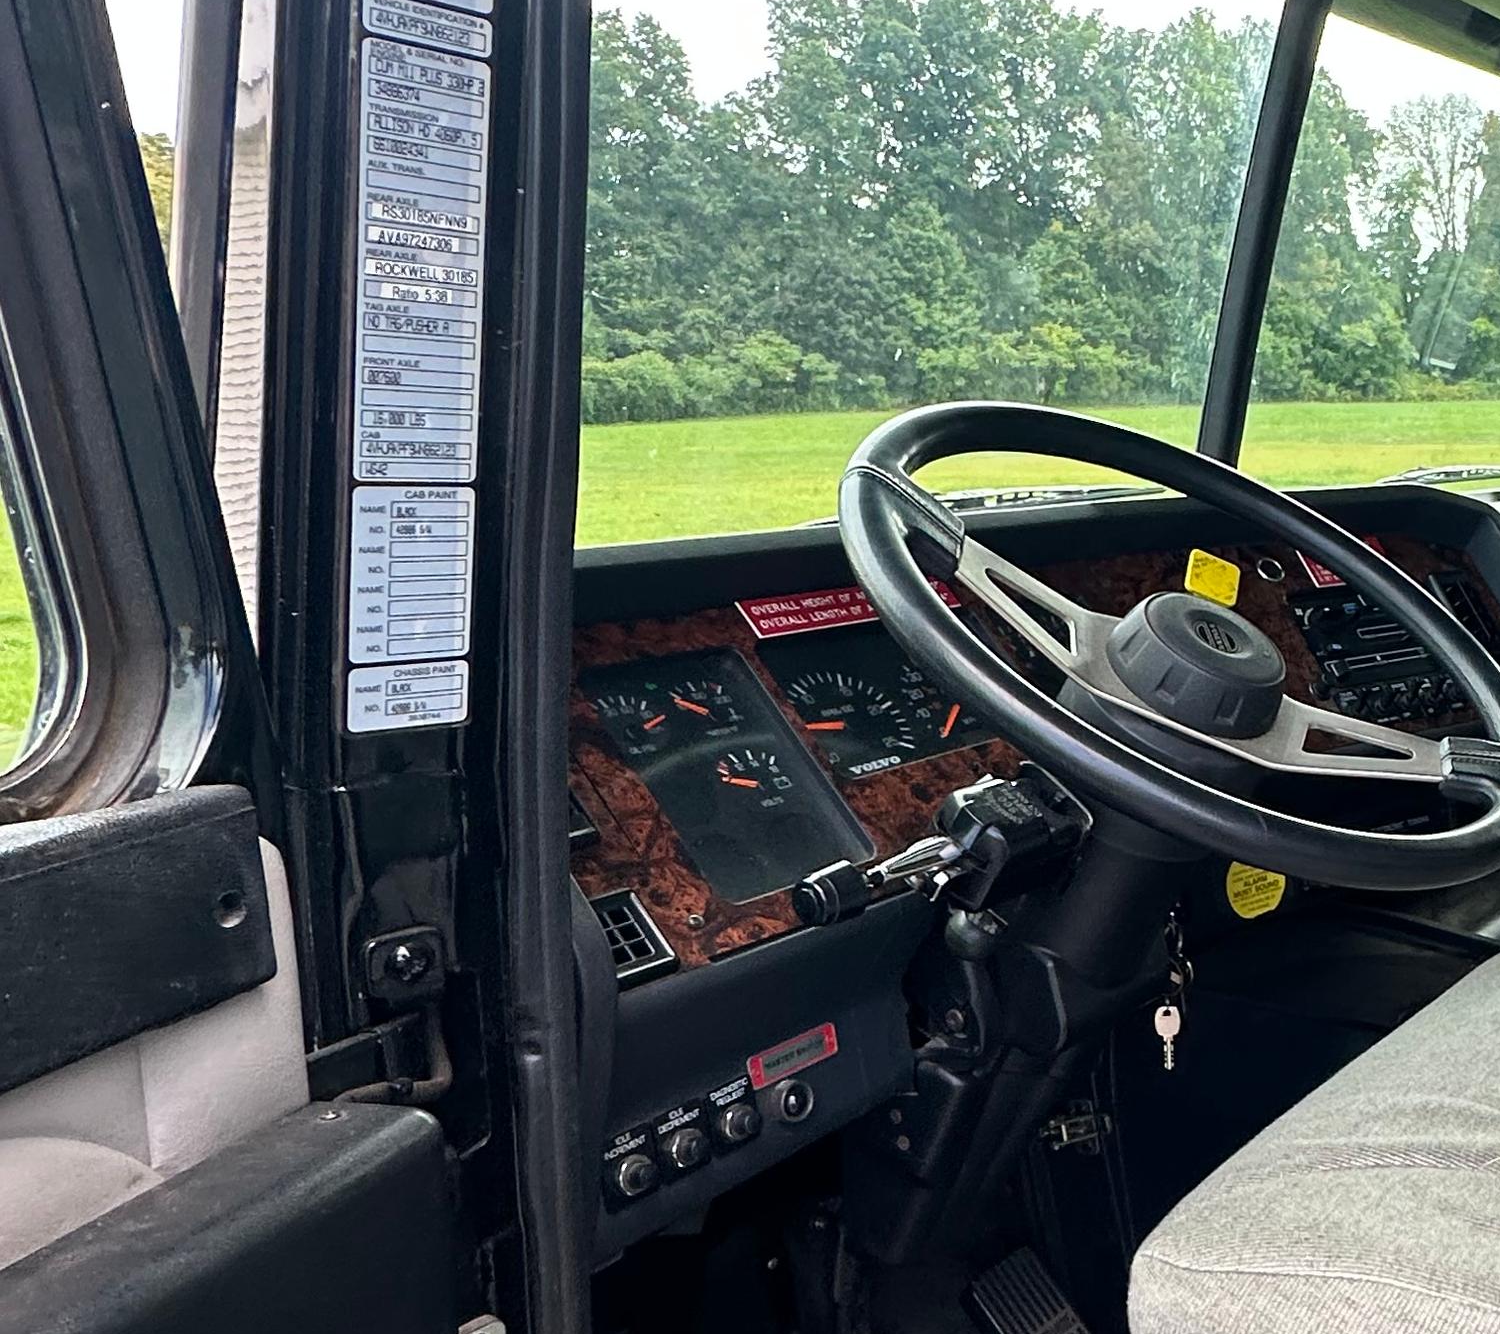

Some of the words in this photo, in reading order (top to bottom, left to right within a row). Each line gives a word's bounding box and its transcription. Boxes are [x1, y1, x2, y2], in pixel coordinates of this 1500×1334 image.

[412, 4, 478, 28] IDENTIFICATION
[420, 68, 443, 85] PLUS
[369, 102, 439, 123] TRANSMISSION
[374, 115, 414, 134] ALLISON
[419, 123, 430, 137] HD
[367, 192, 394, 203] REAR
[396, 196, 419, 207] AXLE
[366, 249, 392, 258] REAR
[394, 252, 418, 262] AXLE
[375, 262, 440, 280] ROCKWELL
[442, 269, 474, 284] 30185
[392, 286, 419, 299] Ratio
[364, 302, 384, 312] TAG
[385, 304, 410, 314] AXLE
[363, 356, 395, 366] FRONT
[397, 358, 421, 368] AXLE
[361, 431, 381, 439] CAB
[404, 490, 426, 499] CAB
[428, 490, 458, 499] PAINT
[359, 505, 386, 514] NAME
[358, 546, 385, 554] NAME
[357, 586, 384, 594] NAME
[751, 599, 800, 615] OVERALL
[801, 595, 836, 609] HEIGHT
[759, 613, 808, 629] OVERALL
[809, 608, 847, 622] LENGTH
[356, 625, 383, 633] NAME
[394, 667, 430, 677] CHASSIS
[432, 665, 456, 674] PAINT
[355, 684, 382, 693] NAME
[849, 755, 901, 774] VOLVO
[709, 1076, 748, 1101] DIAGNOSTIC
[715, 1087, 745, 1107] REQUEST
[668, 1107, 684, 1120] IDLE
[657, 1108, 700, 1134] DECREMENT
[614, 1132, 631, 1145] IDLE
[604, 1134, 646, 1160] INCREMENT
